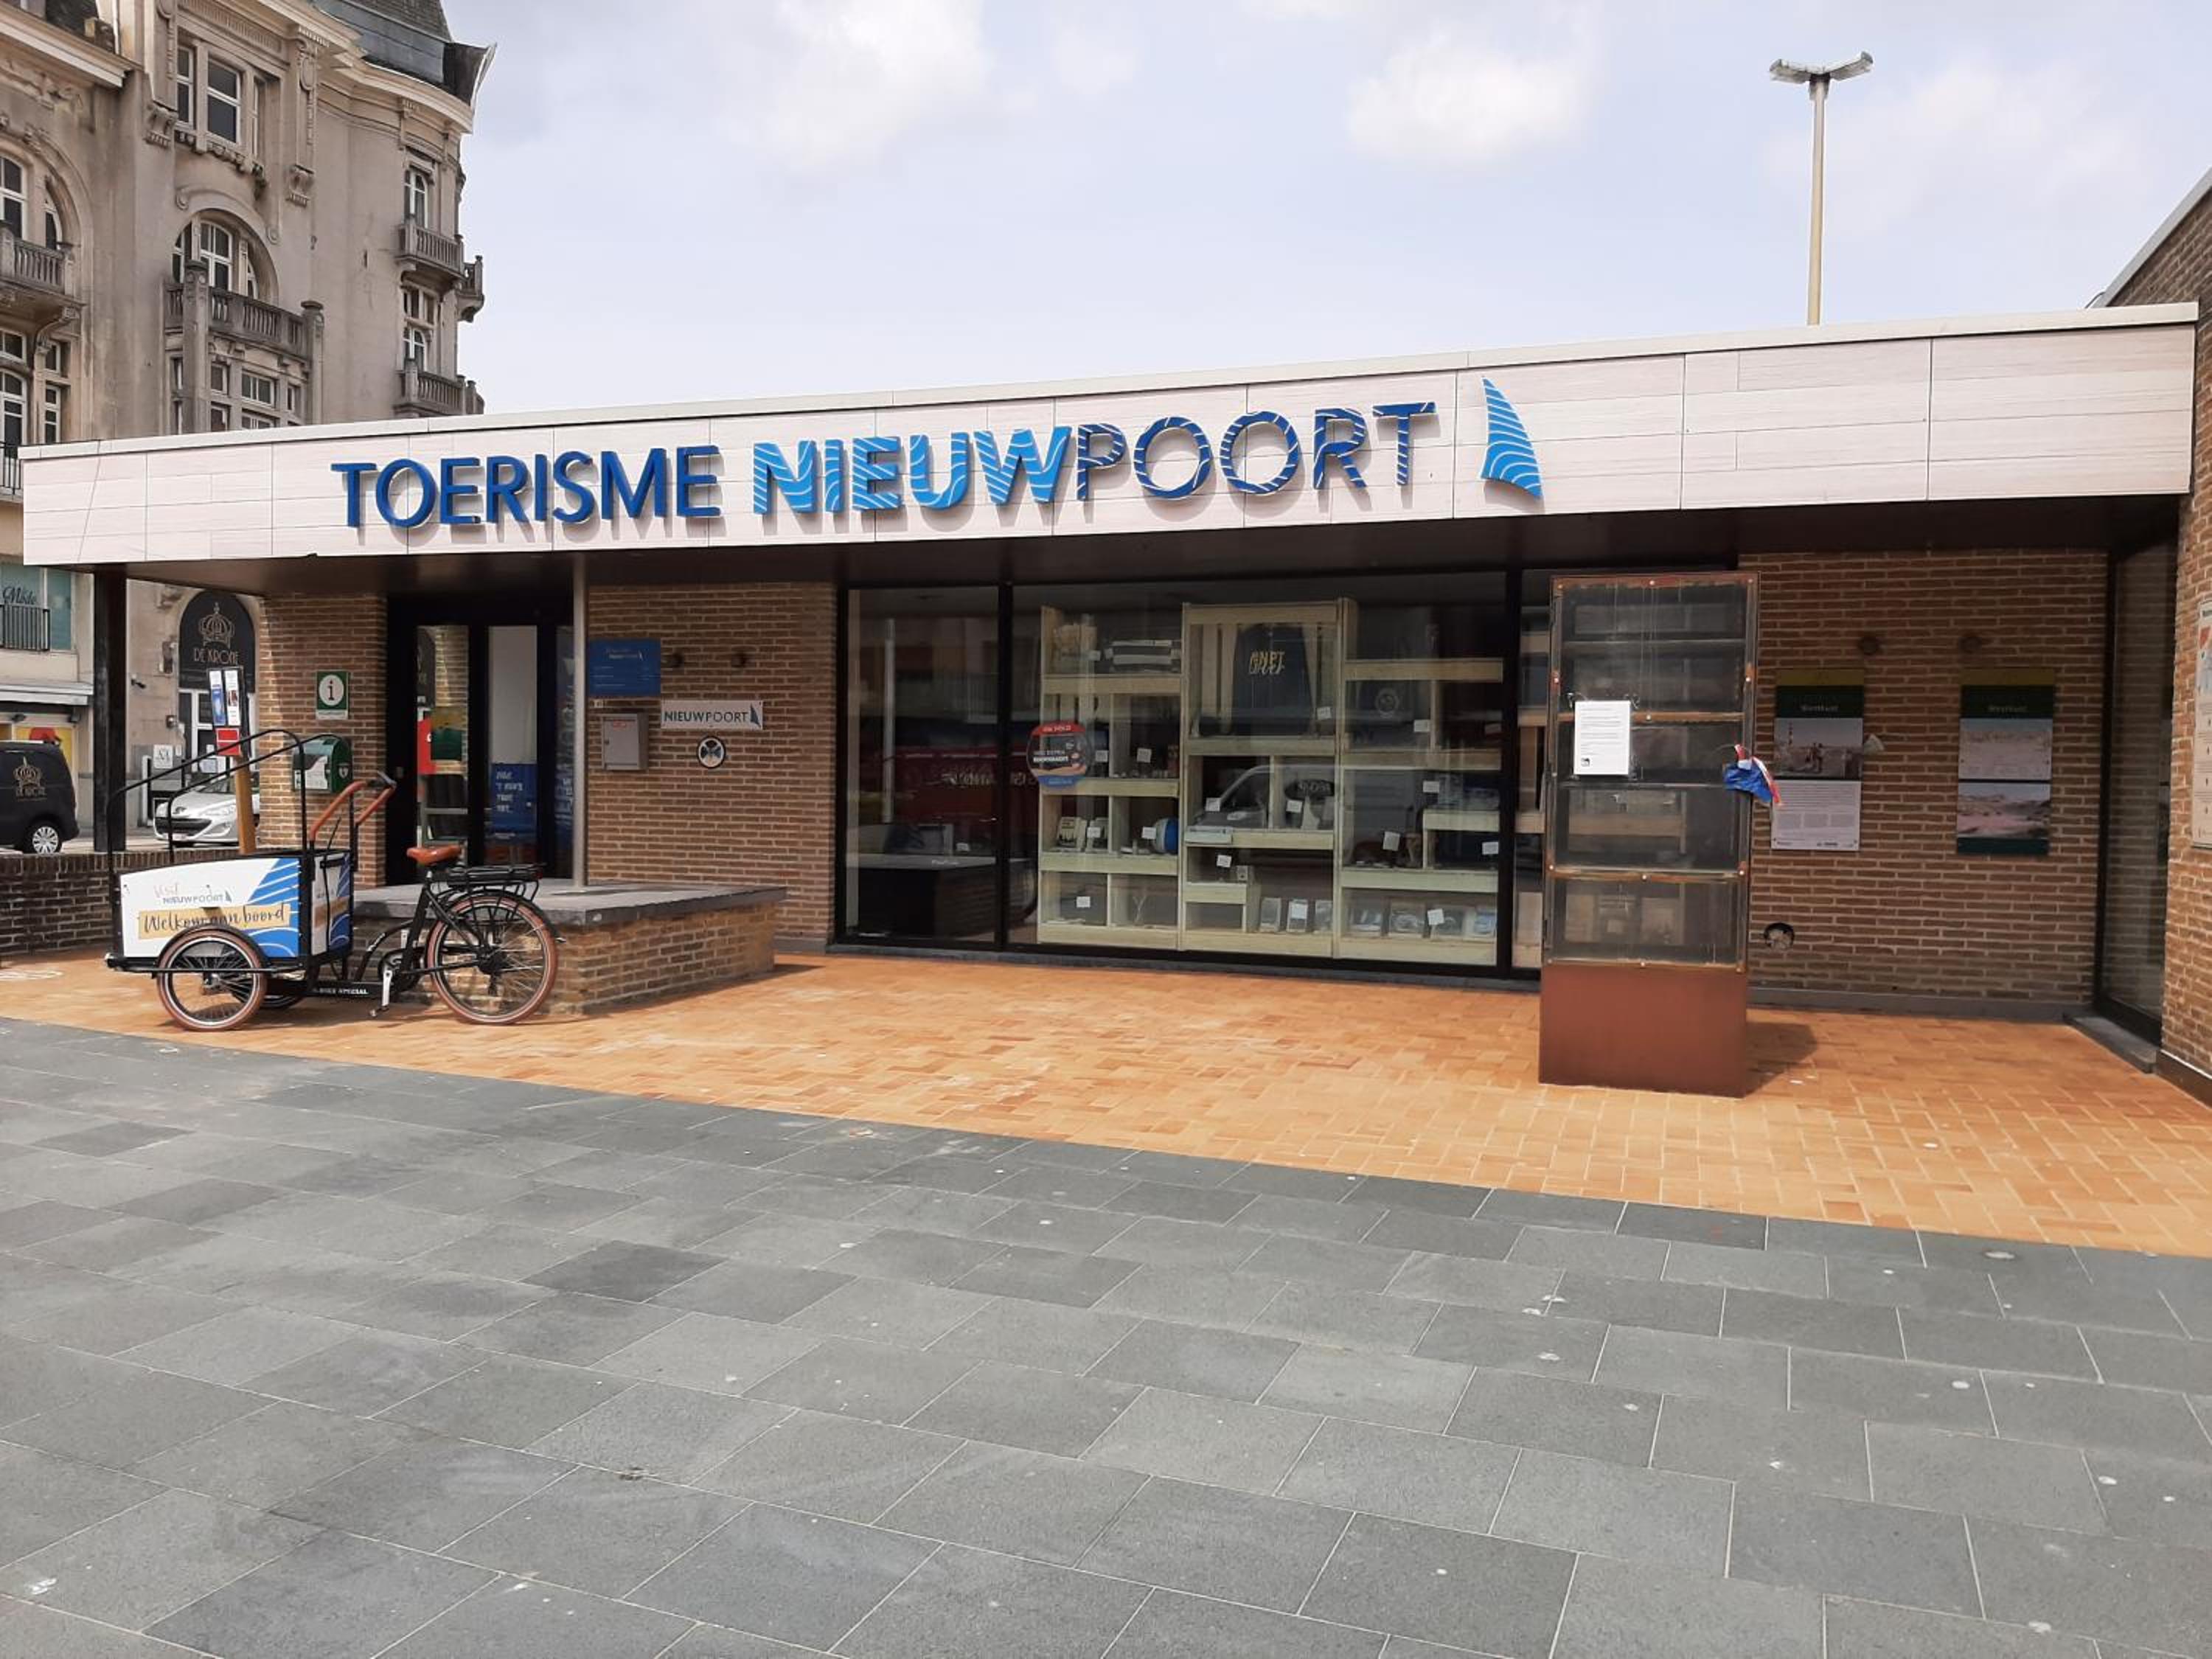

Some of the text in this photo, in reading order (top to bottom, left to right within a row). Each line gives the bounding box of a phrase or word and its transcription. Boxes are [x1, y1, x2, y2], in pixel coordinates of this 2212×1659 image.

[330, 402, 1437, 529] TOERISME NIEUWPOORT
[194, 647, 204, 663] DE
[664, 710, 748, 723] NIEUWPOORT
[163, 894, 224, 905] NIEUWPOORT
[243, 902, 285, 923] boord
